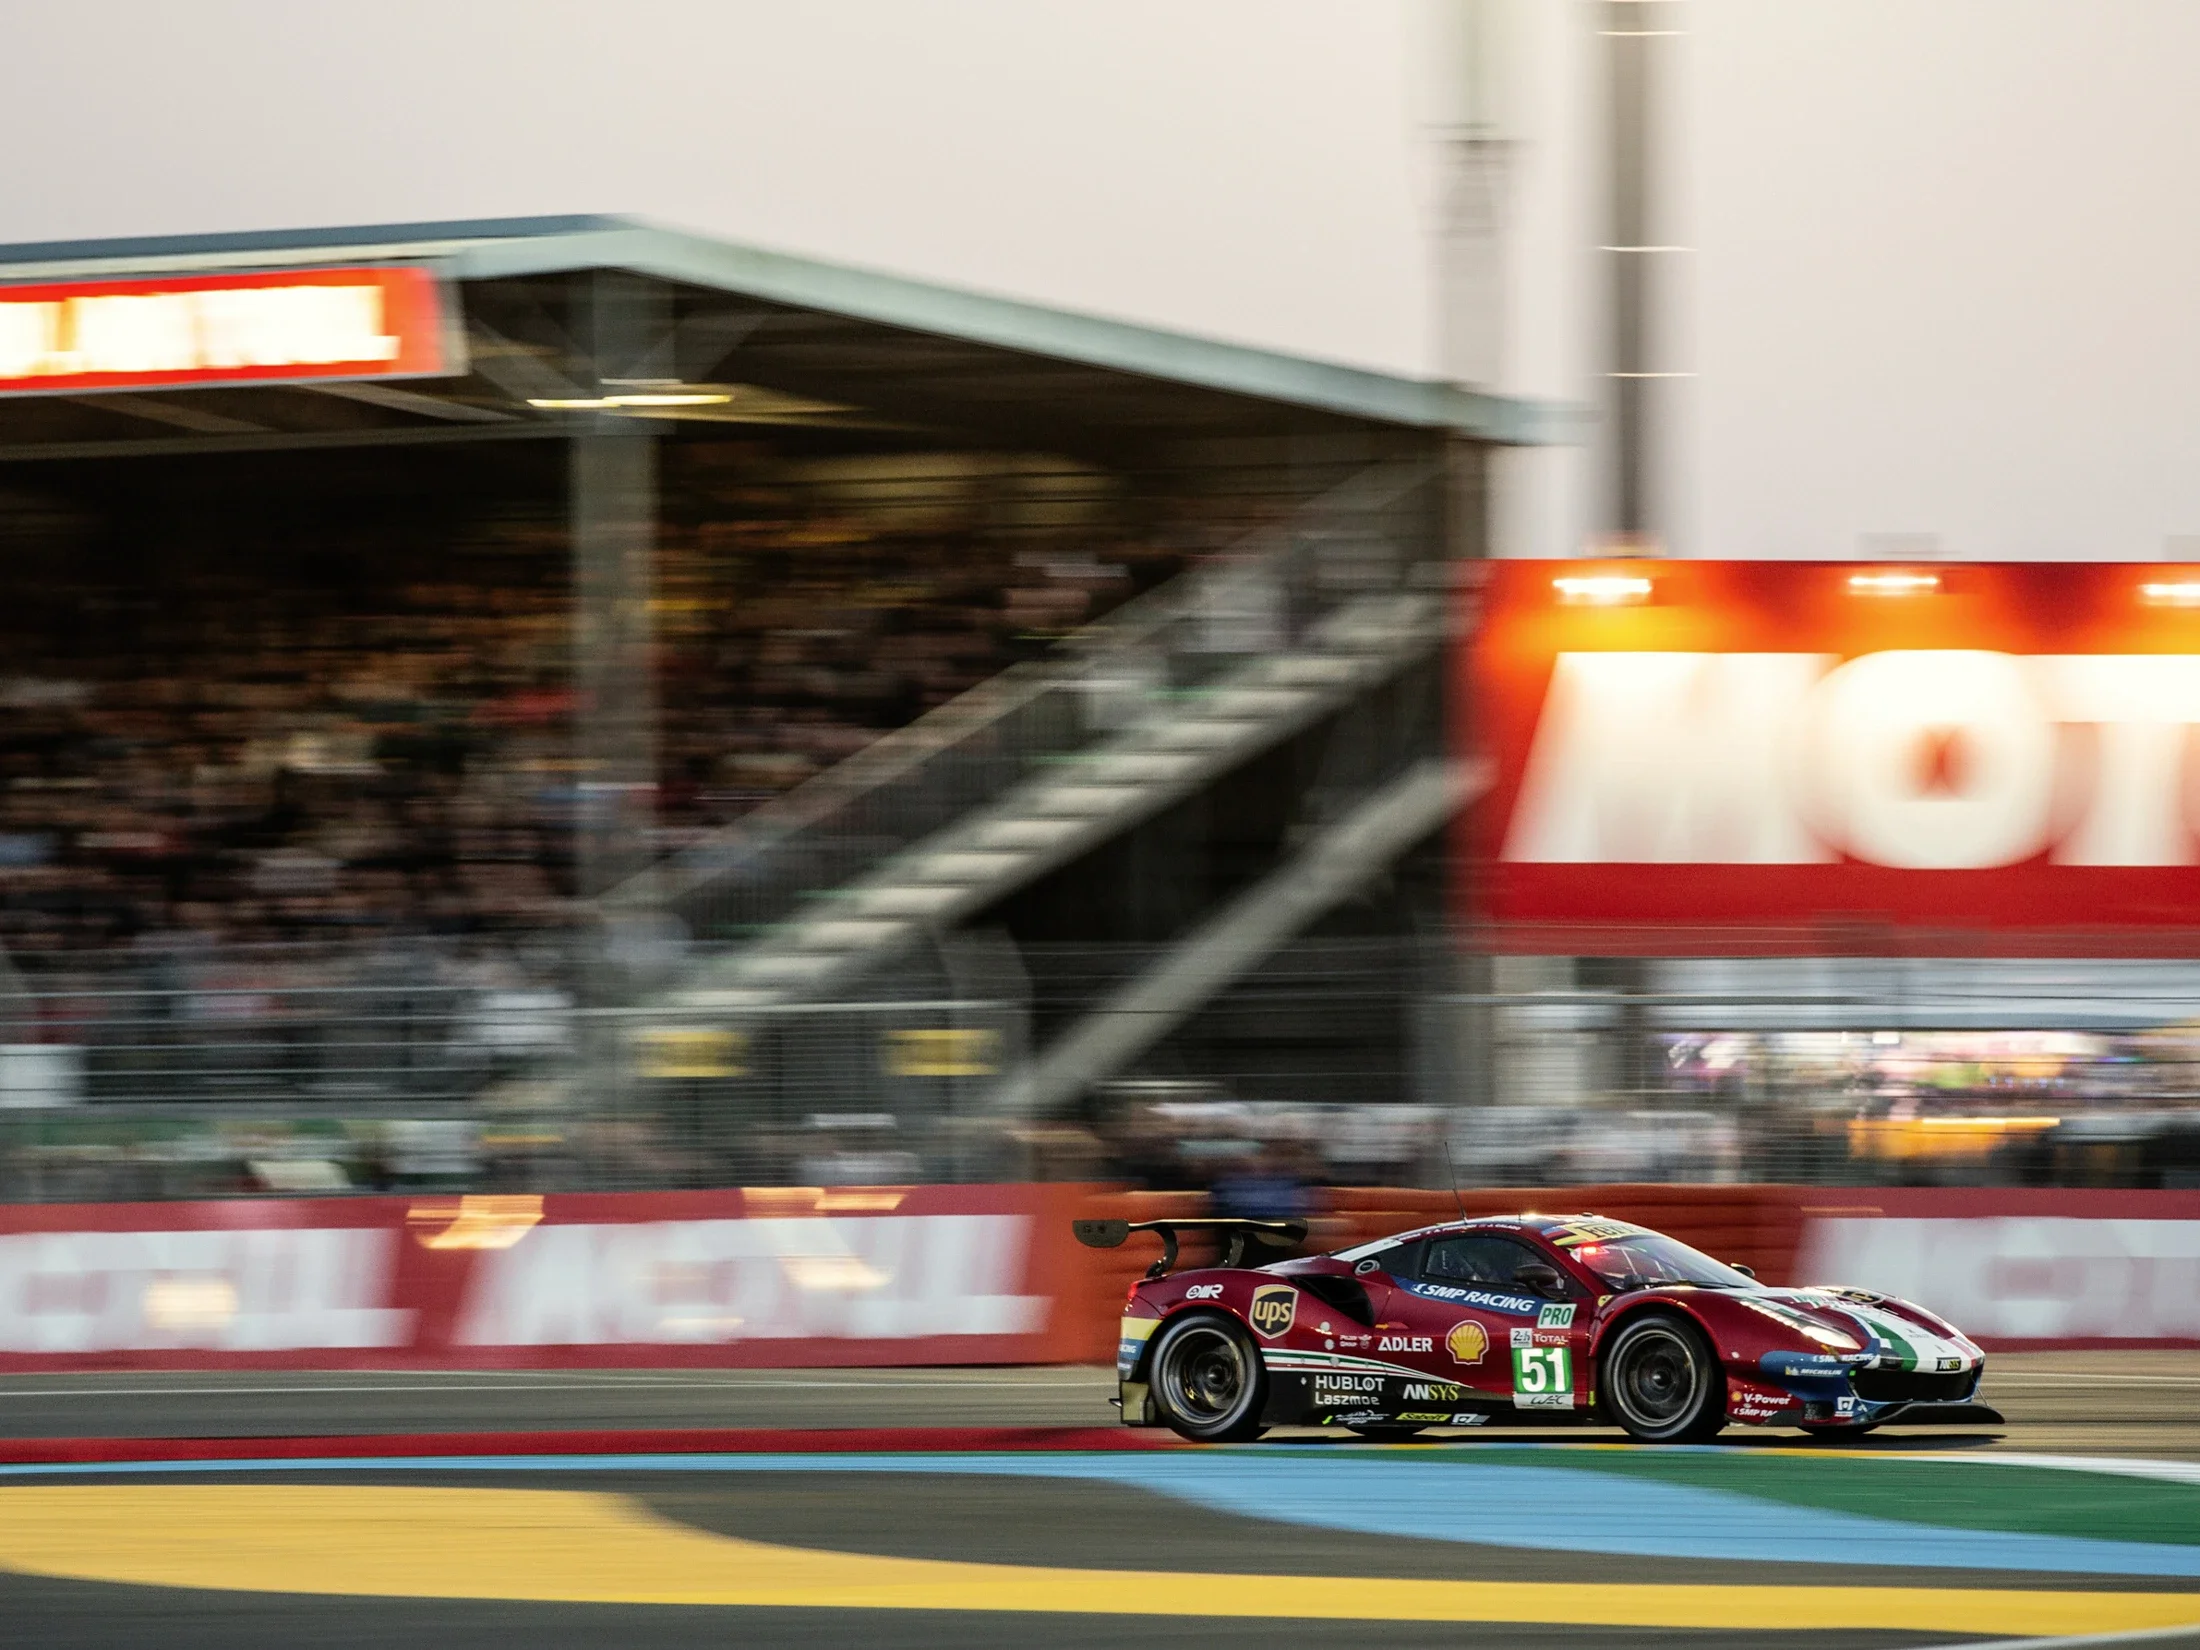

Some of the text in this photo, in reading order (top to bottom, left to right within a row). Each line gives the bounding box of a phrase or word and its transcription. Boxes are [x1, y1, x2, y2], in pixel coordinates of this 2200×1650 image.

[1423, 1284, 1535, 1312] SMP RACING
[1254, 1300, 1292, 1329] ups
[1540, 1307, 1572, 1325] PRO
[1377, 1336, 1433, 1352] ADLER
[1520, 1348, 1566, 1392] 51
[1801, 1368, 1843, 1376] MICHELIN
[1315, 1375, 1385, 1392] HUBLOT
[1403, 1384, 1460, 1401] ANSYS
[1743, 1393, 1791, 1405] V-Power
[1738, 1407, 1760, 1416] SMP
